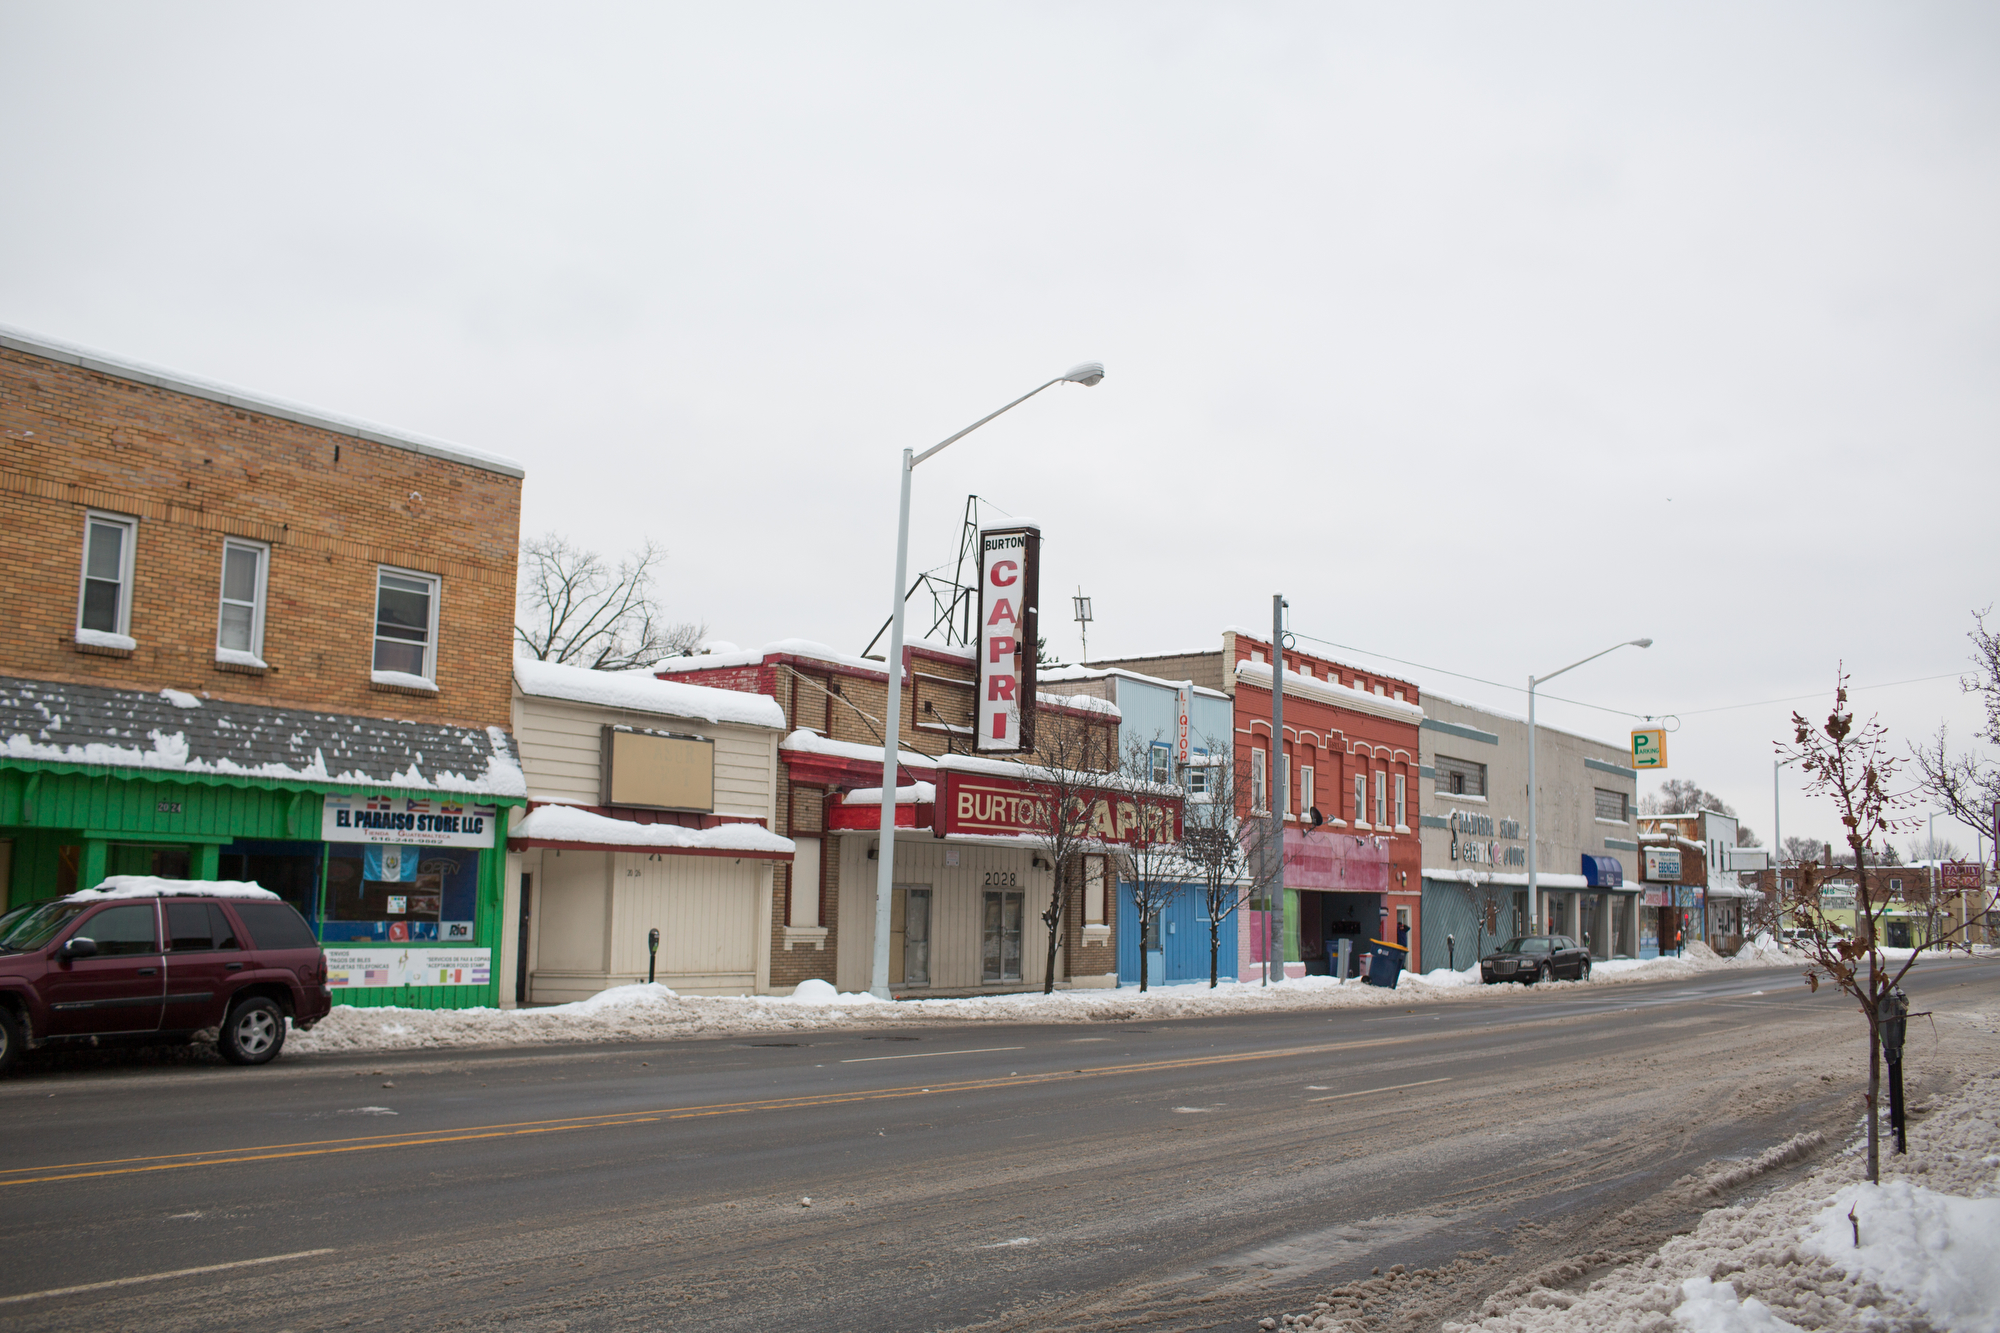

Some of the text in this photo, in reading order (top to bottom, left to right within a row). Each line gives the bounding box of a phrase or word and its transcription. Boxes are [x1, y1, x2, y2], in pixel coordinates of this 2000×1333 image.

[985, 536, 1025, 551] BURTON
[987, 560, 1018, 739] CAPRI
[1179, 691, 1188, 763] LIQUOR
[1634, 735, 1660, 755] PARKING
[336, 809, 484, 835] EL PARAISO STORE LLC
[957, 791, 1175, 844] BURTON CAPRI
[985, 872, 1016, 886] 2028
[449, 924, 467, 936] Ria
